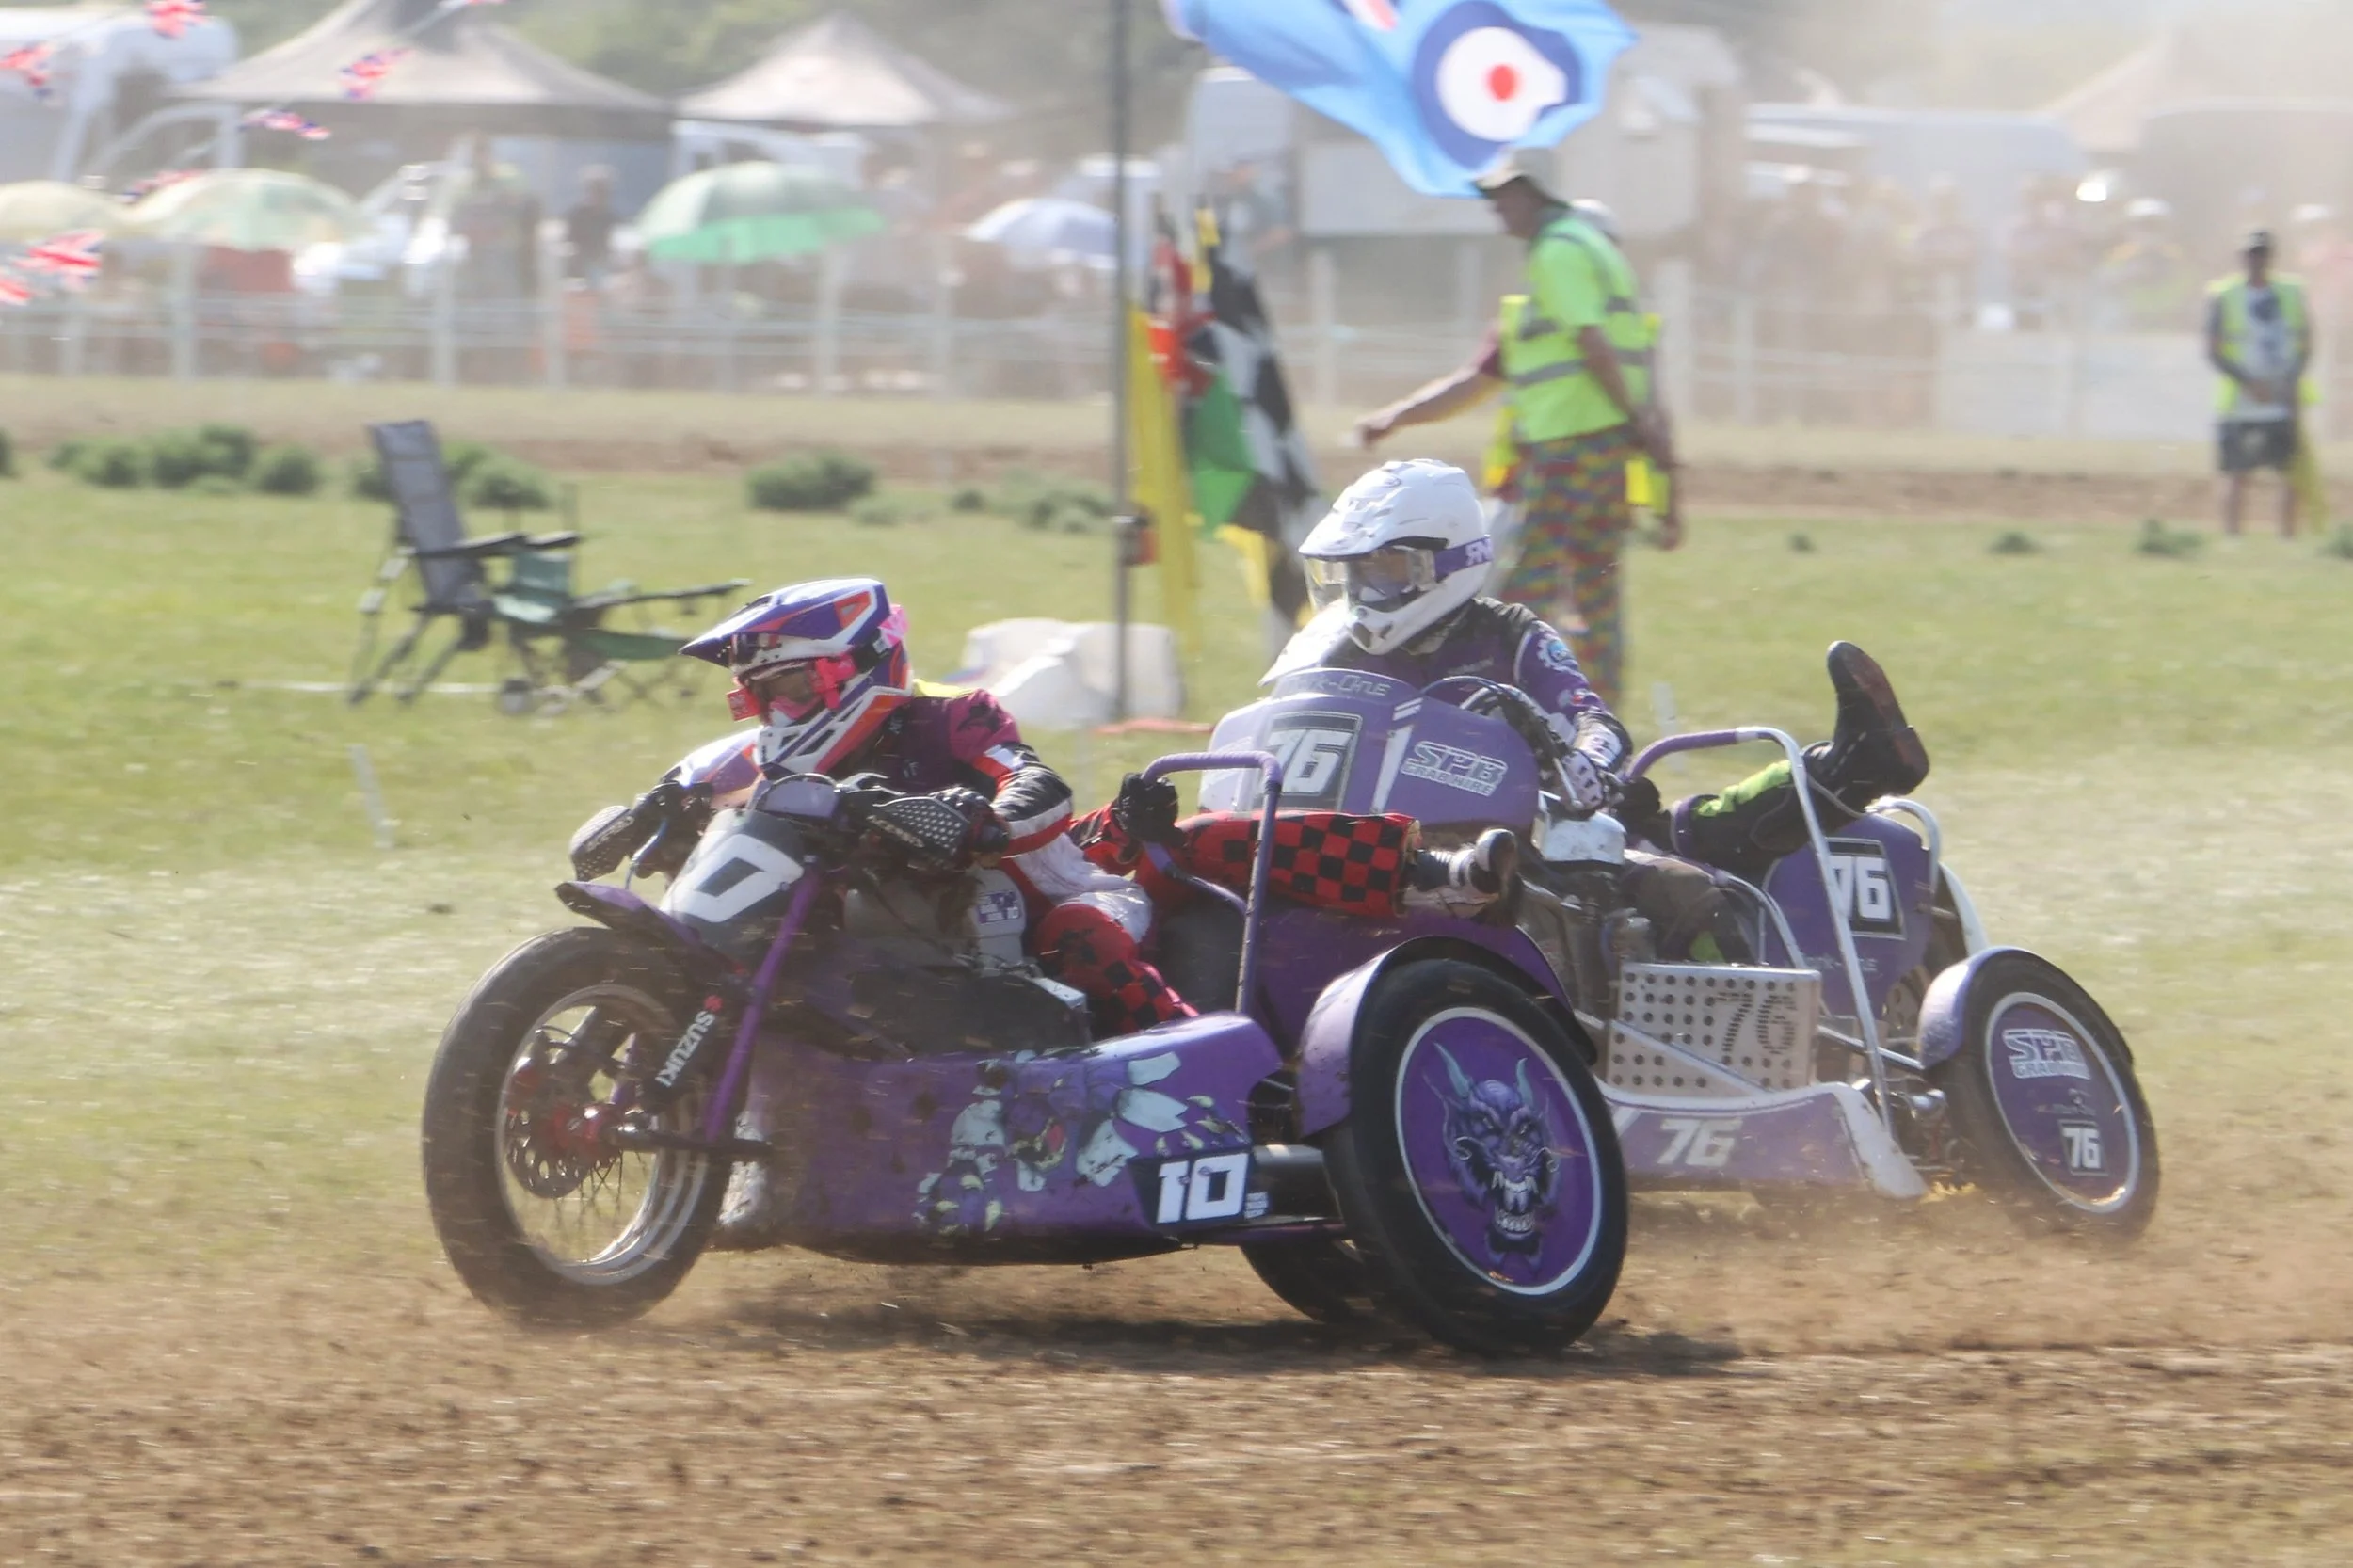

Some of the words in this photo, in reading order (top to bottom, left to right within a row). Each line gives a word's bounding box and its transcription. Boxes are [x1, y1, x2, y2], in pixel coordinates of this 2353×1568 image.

[1267, 728, 1353, 793] 76
[1403, 740, 1509, 788] SPB
[655, 1010, 715, 1088] SUZUKI
[1715, 991, 1797, 1055] 76
[1657, 1117, 1744, 1167] 76
[2062, 1127, 2102, 1170] 76
[1156, 1153, 1250, 1224] 10
